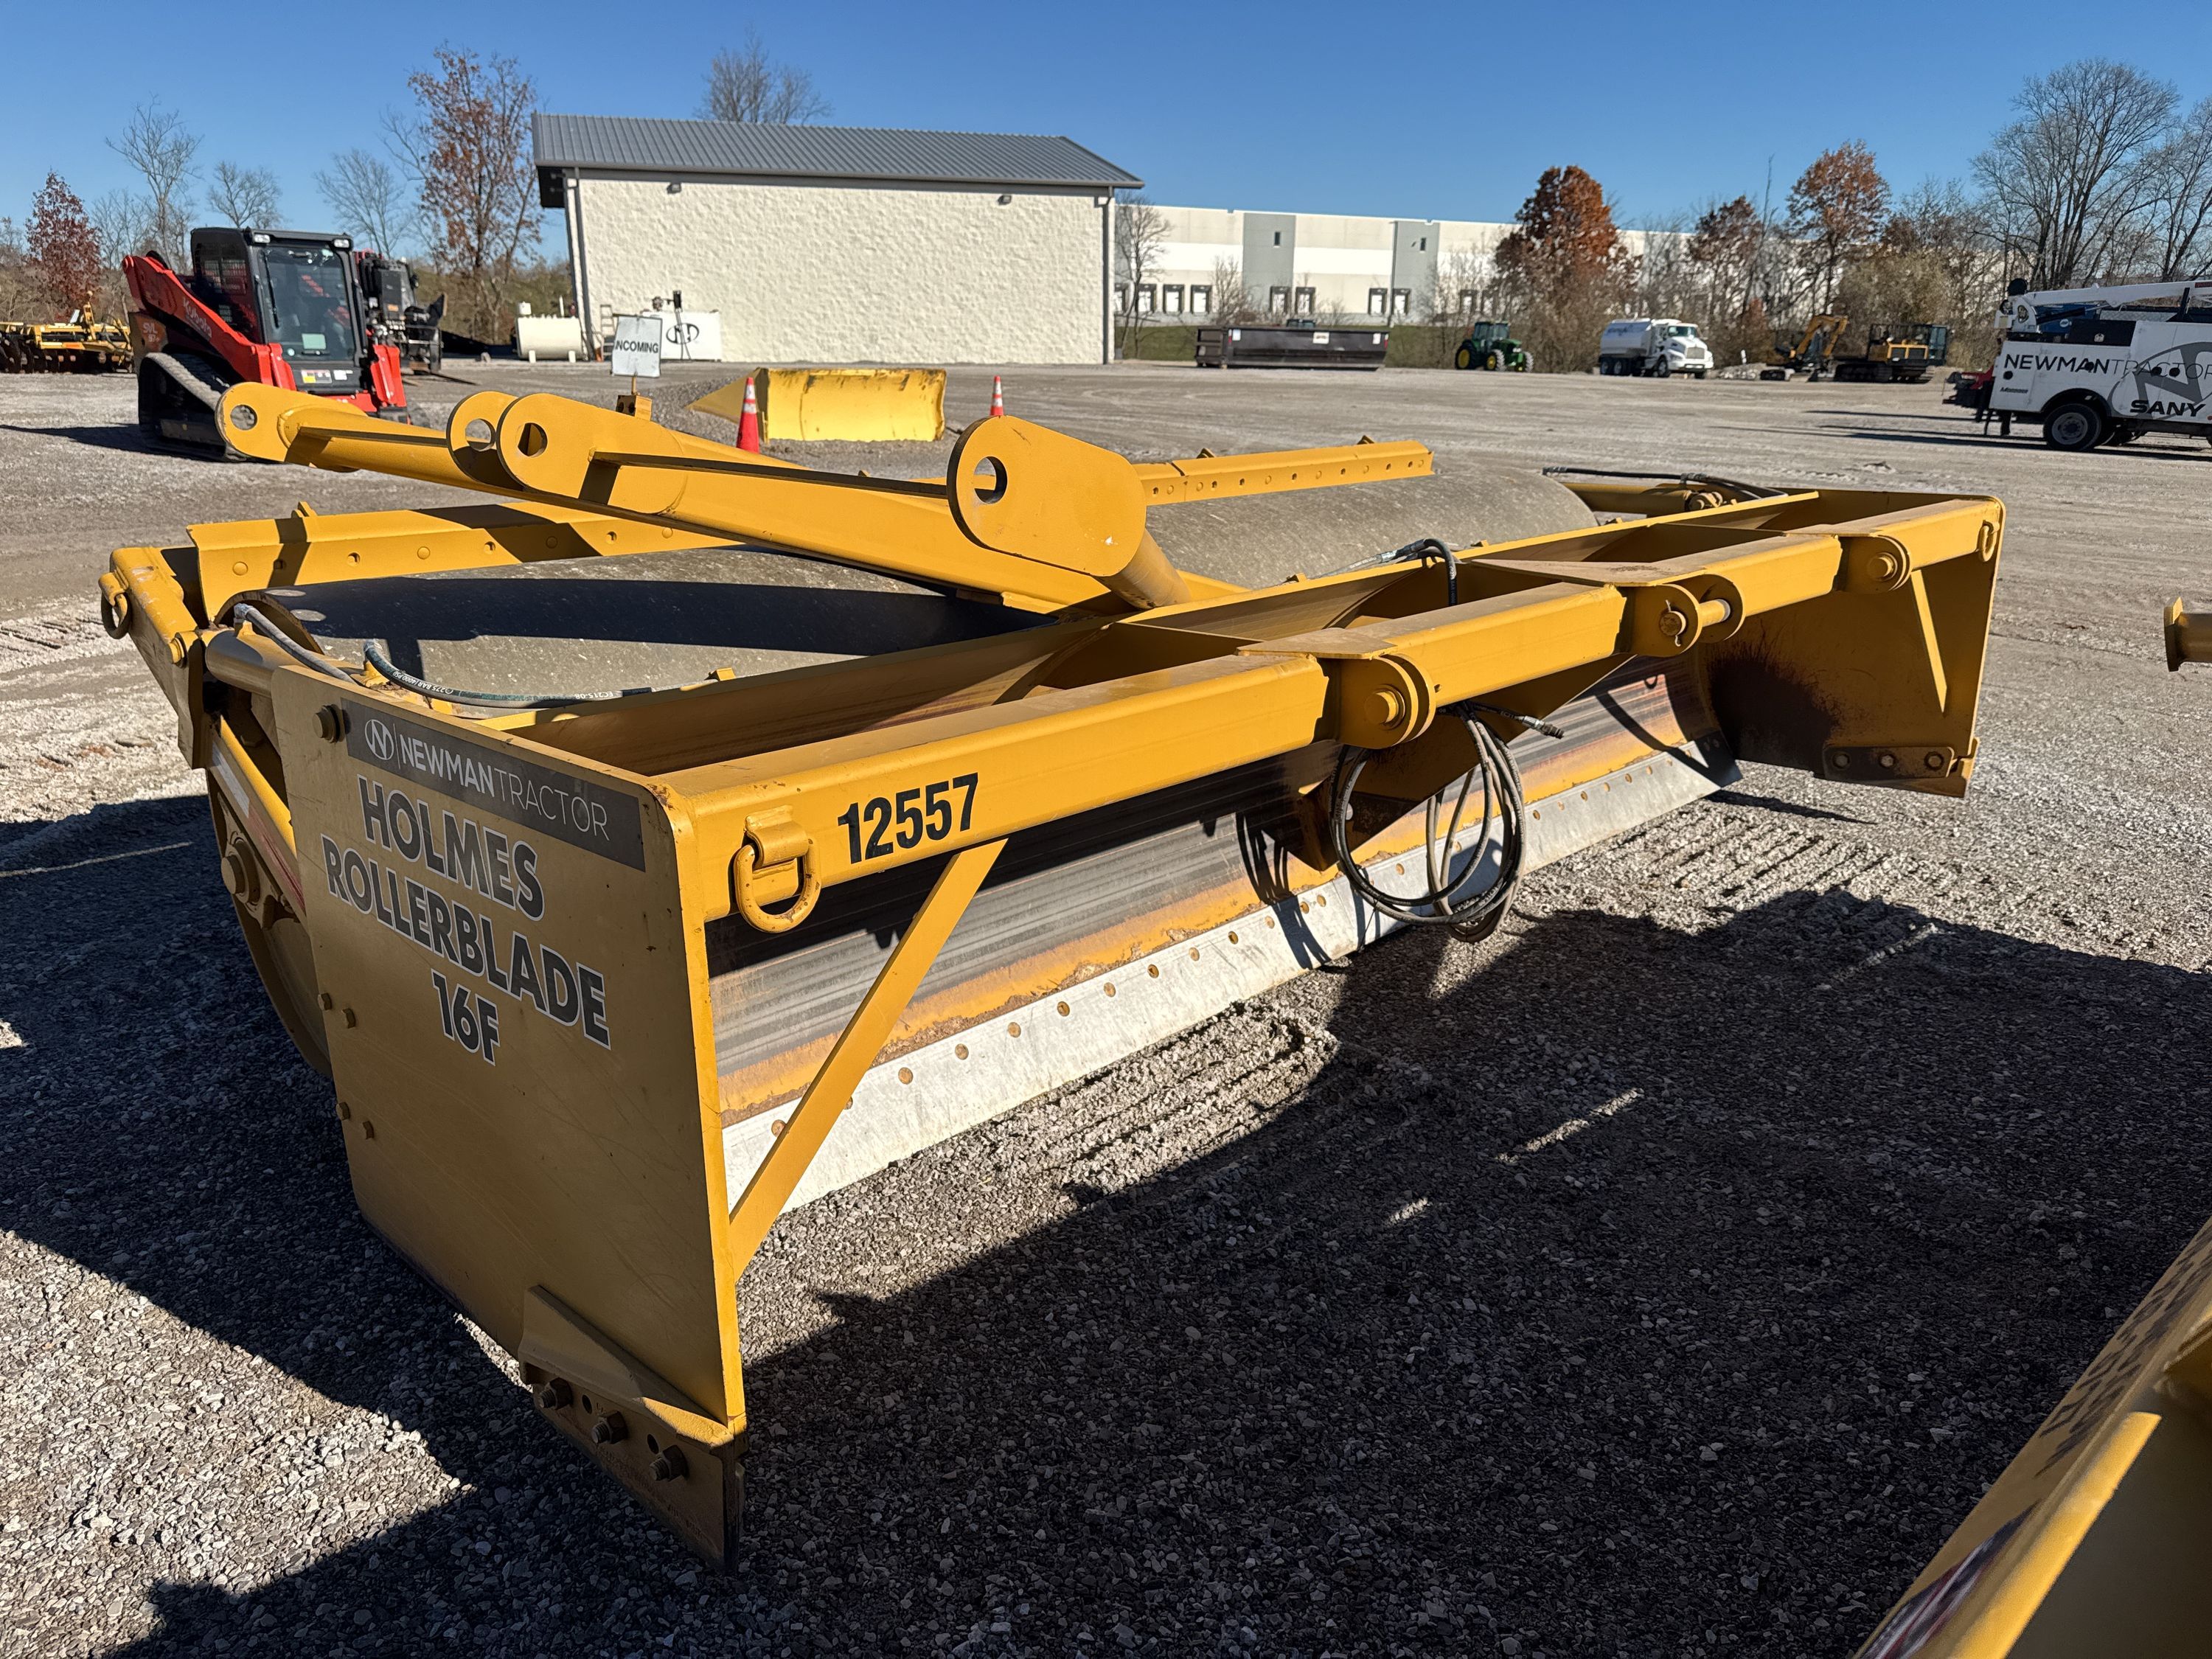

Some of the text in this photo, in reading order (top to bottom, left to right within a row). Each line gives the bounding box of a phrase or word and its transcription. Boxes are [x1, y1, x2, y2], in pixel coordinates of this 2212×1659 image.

[615, 340, 659, 354] INCOMING
[2130, 400, 2206, 417] SANY
[418, 680, 432, 690] BAR
[357, 773, 545, 922] HOLMES
[837, 772, 979, 864] 12557
[320, 833, 611, 1051] ROLLERBLADE
[431, 968, 501, 1066] 16F
